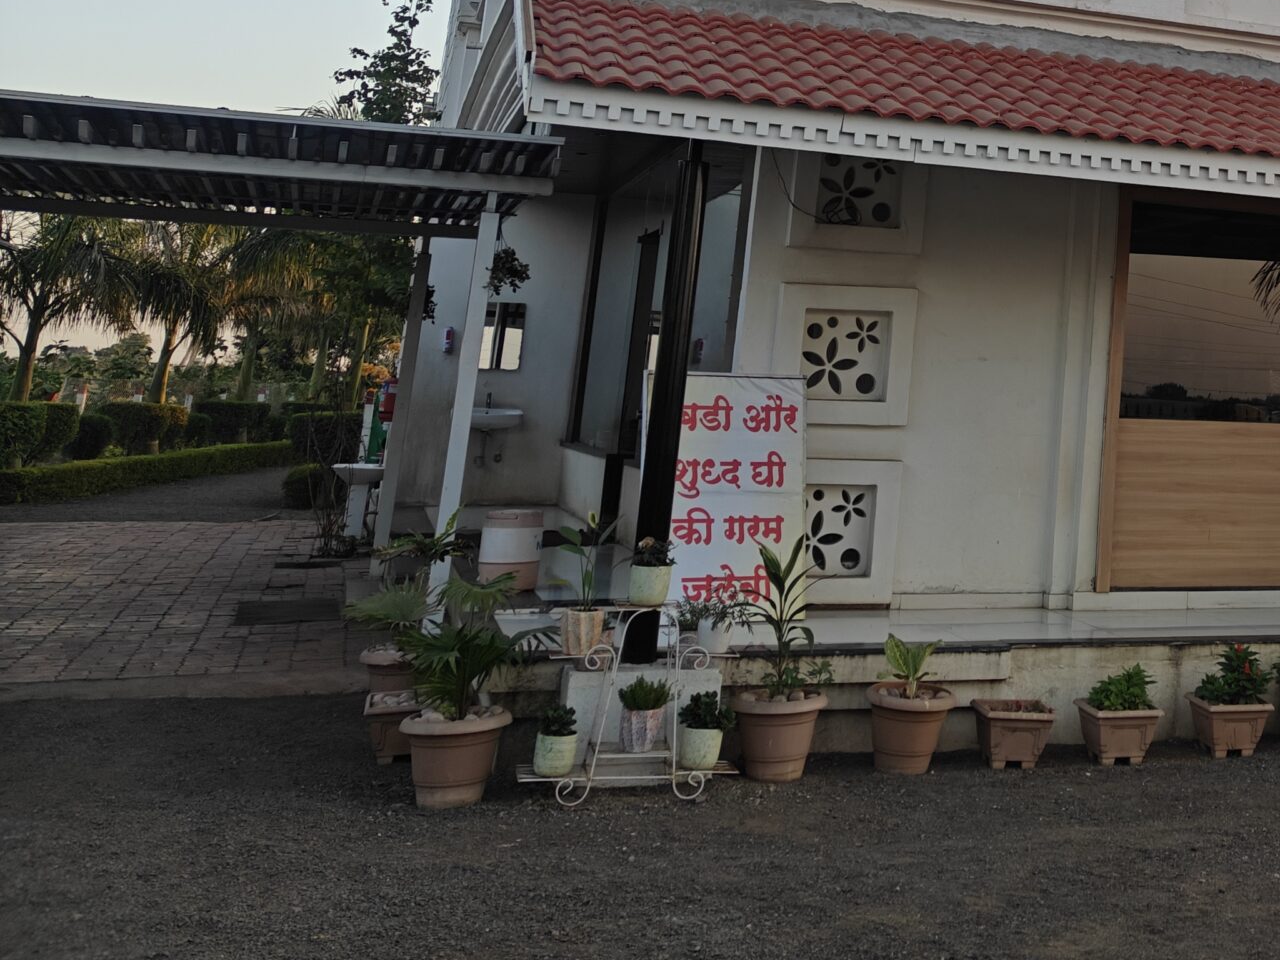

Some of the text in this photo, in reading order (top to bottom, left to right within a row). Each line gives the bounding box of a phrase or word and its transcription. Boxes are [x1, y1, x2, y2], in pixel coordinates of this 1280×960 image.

[680, 394, 799, 434] बडी और
[750, 450, 786, 488] घी
[671, 506, 784, 546] की गरम
